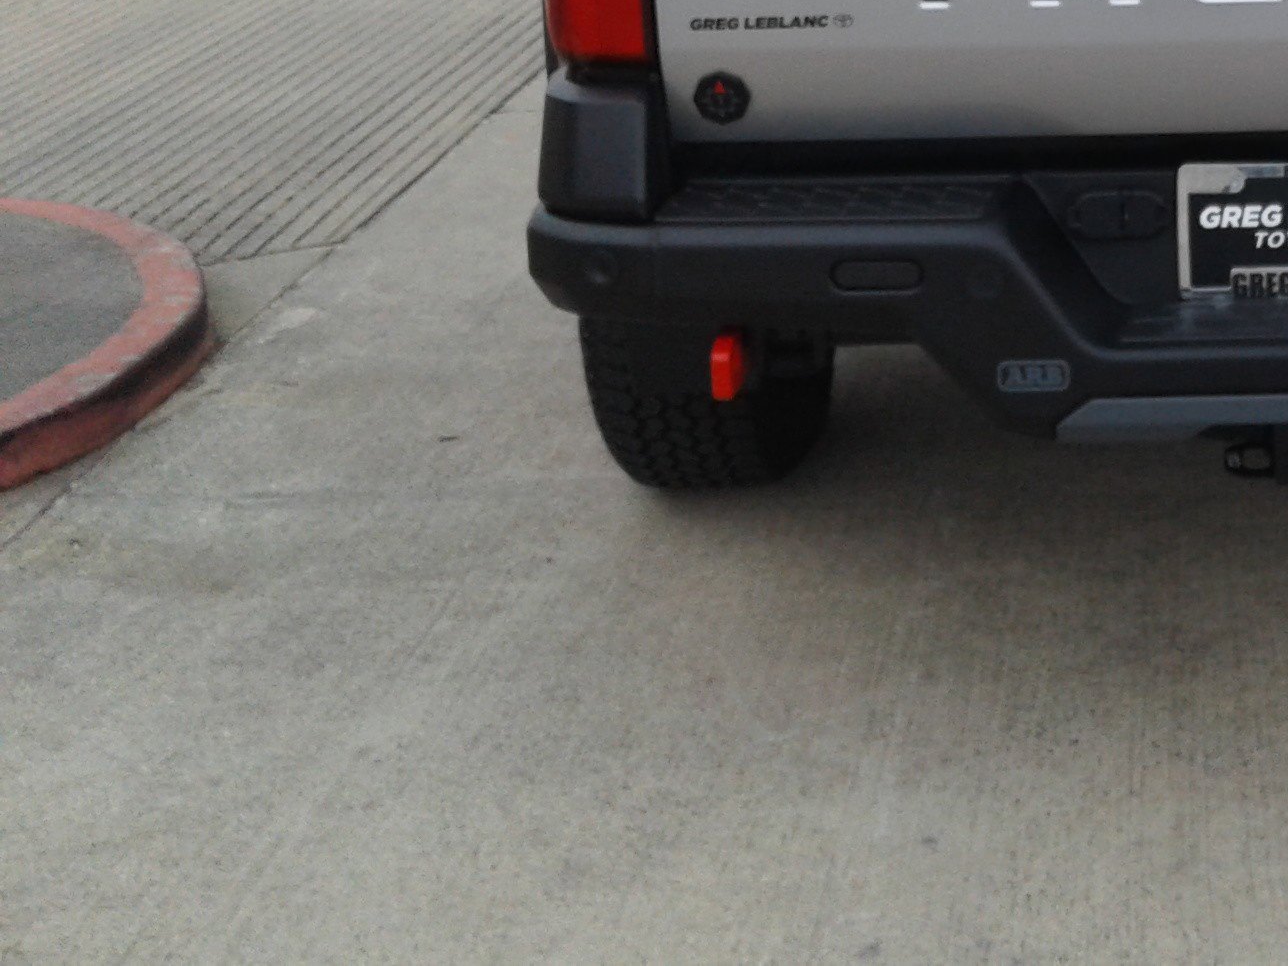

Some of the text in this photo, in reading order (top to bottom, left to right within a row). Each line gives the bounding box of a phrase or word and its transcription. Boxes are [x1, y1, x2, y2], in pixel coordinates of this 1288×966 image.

[689, 15, 829, 31] GREG LEBLANC
[1199, 205, 1284, 229] GREG
